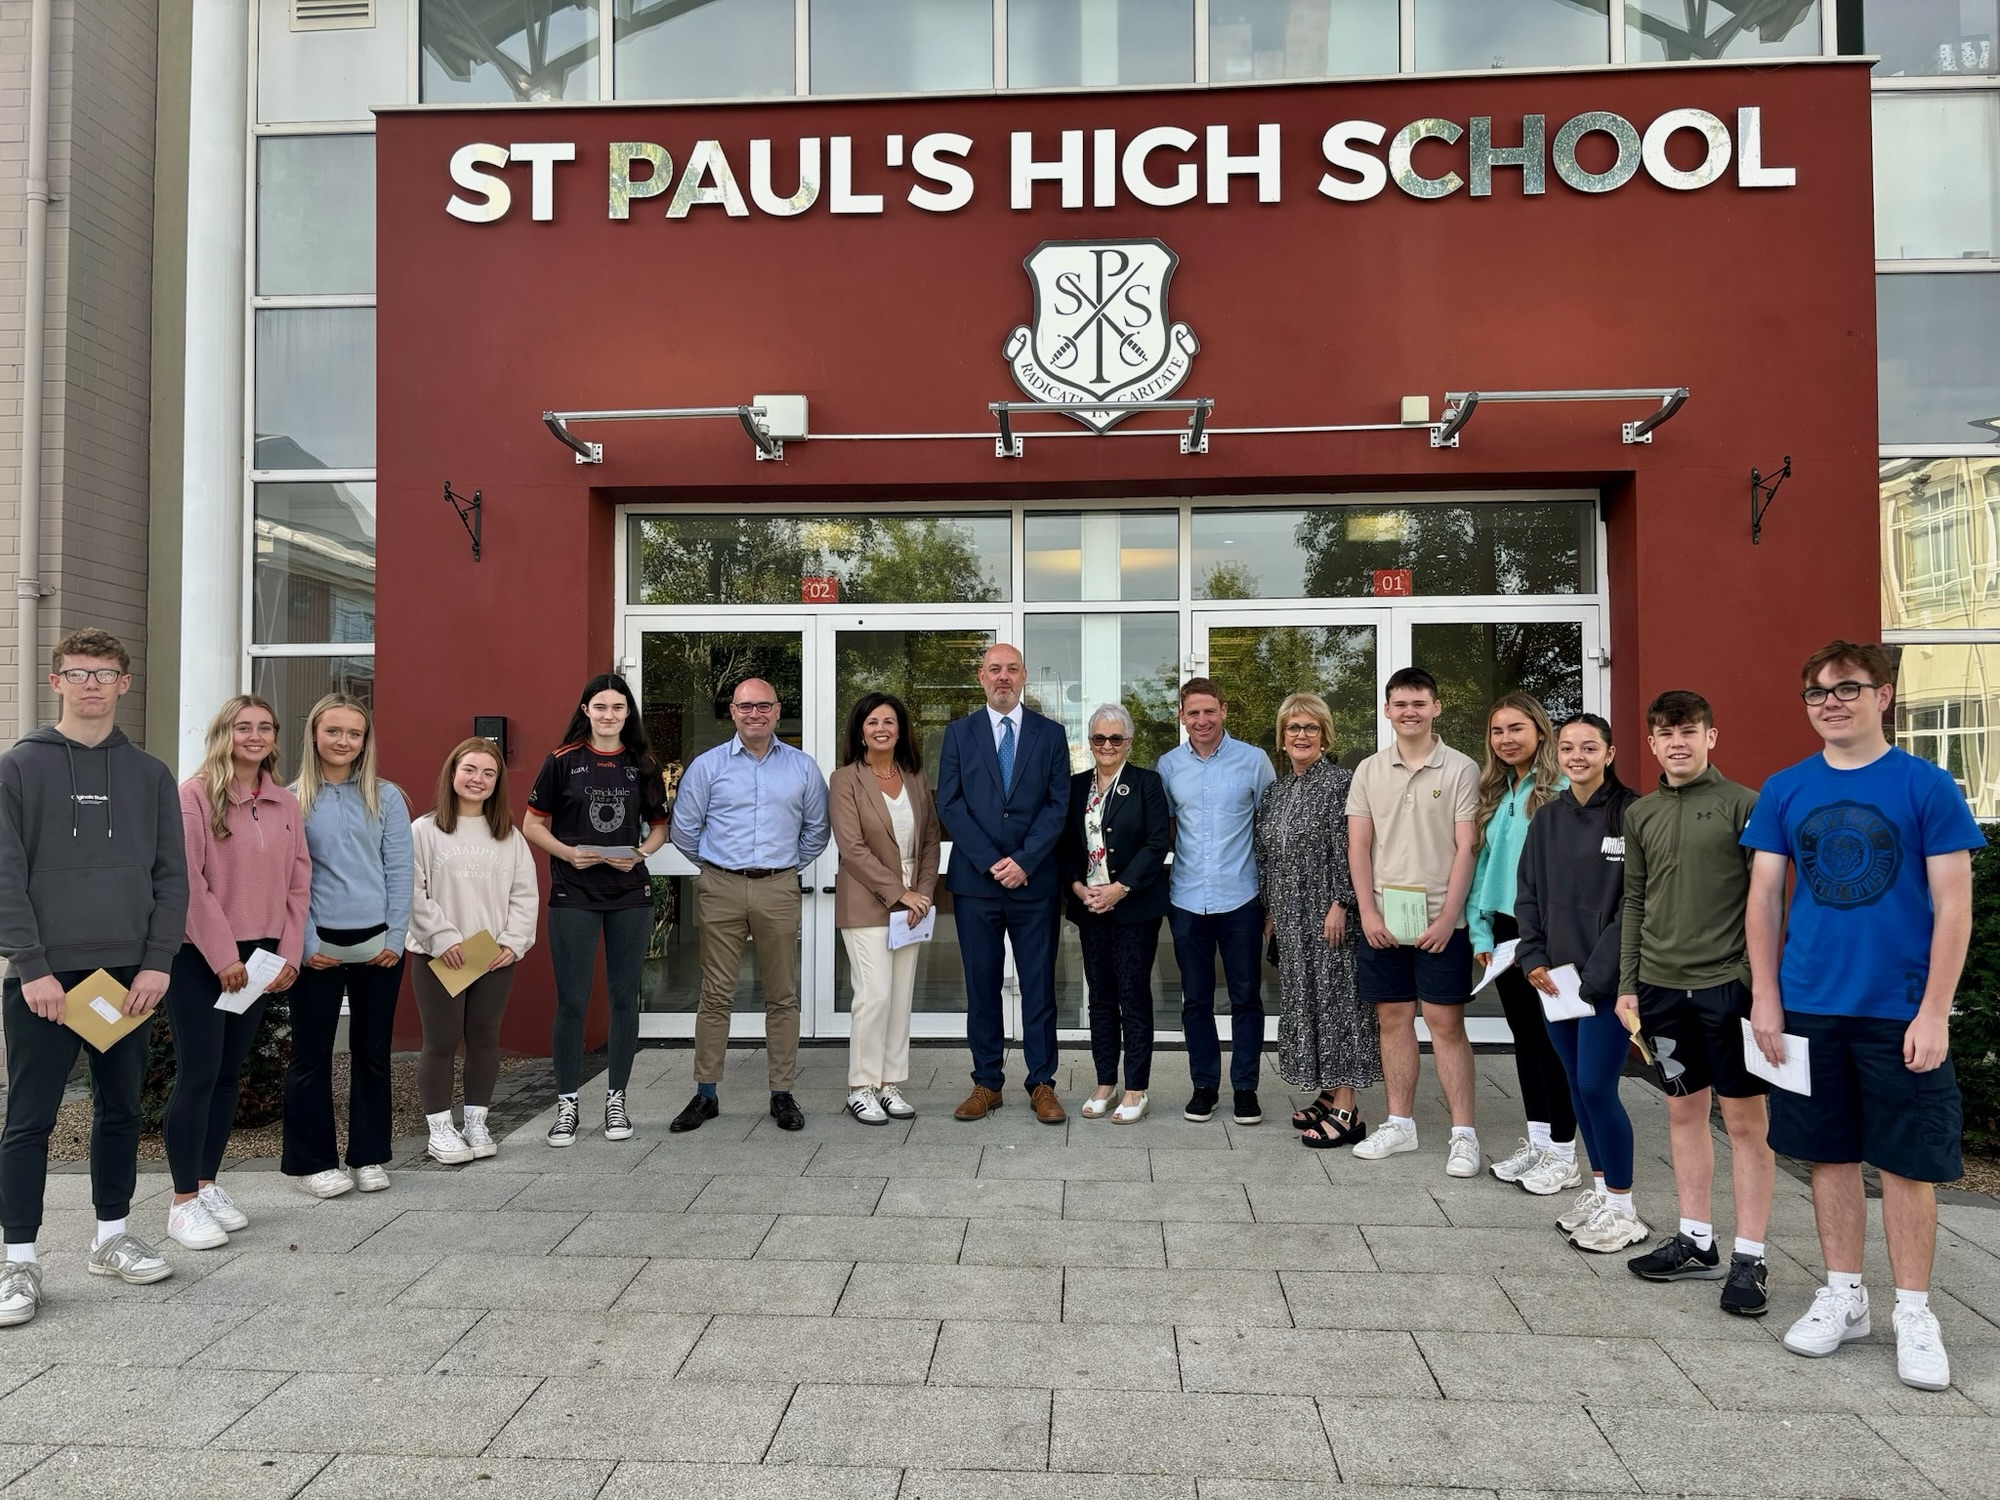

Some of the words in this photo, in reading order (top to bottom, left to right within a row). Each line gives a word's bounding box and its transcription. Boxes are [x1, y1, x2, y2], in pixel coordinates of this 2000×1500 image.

[446, 142, 575, 223] ST
[608, 131, 975, 219] PAUL'S
[1010, 123, 1281, 209] HIGH
[1317, 106, 1796, 202] SCHOOL
[1117, 356, 1185, 402] CARITATE
[810, 582, 831, 598] 02
[1382, 575, 1404, 591] 01
